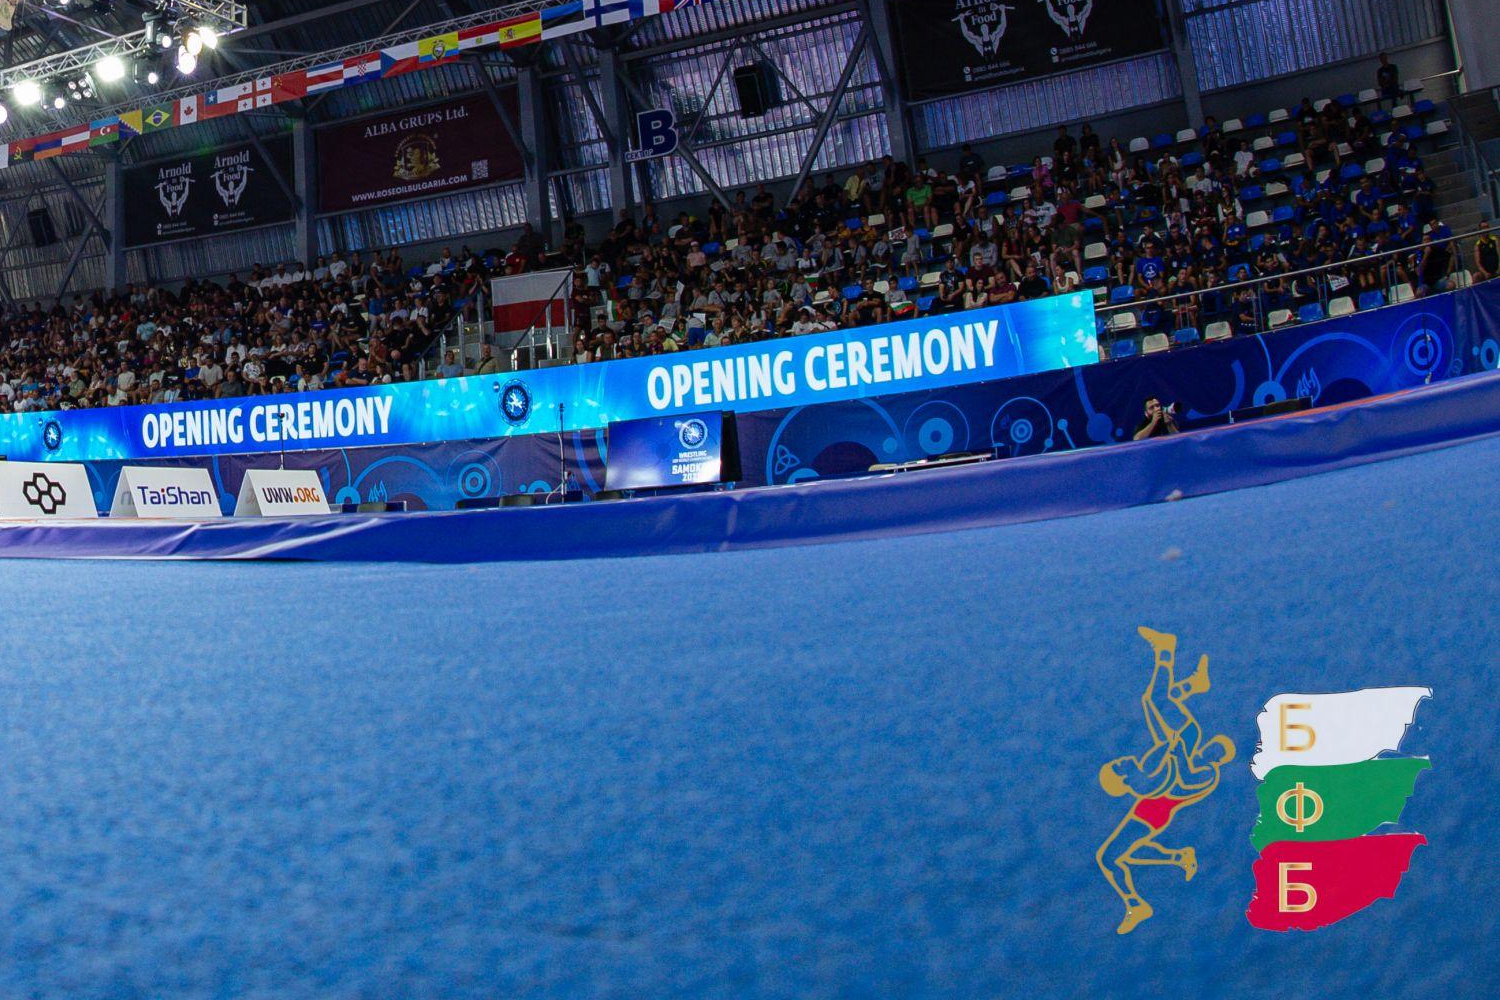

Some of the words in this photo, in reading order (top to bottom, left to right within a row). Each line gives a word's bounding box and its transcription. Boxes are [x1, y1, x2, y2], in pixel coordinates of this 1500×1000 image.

[364, 122, 397, 138] ALBA
[399, 110, 442, 130] GRUPS
[446, 105, 469, 120] Ltd.
[214, 149, 250, 168] Arnold
[157, 162, 192, 180] Arnold
[351, 174, 468, 202] WWW.ROSEOILBULGARIA.COM
[647, 351, 796, 410] OPENING
[804, 319, 999, 391] CEREMONY
[142, 407, 244, 449] OPENING
[251, 395, 393, 443] CEREMONY
[137, 486, 212, 505] TaiShan
[262, 487, 320, 504] UWW.ORG
